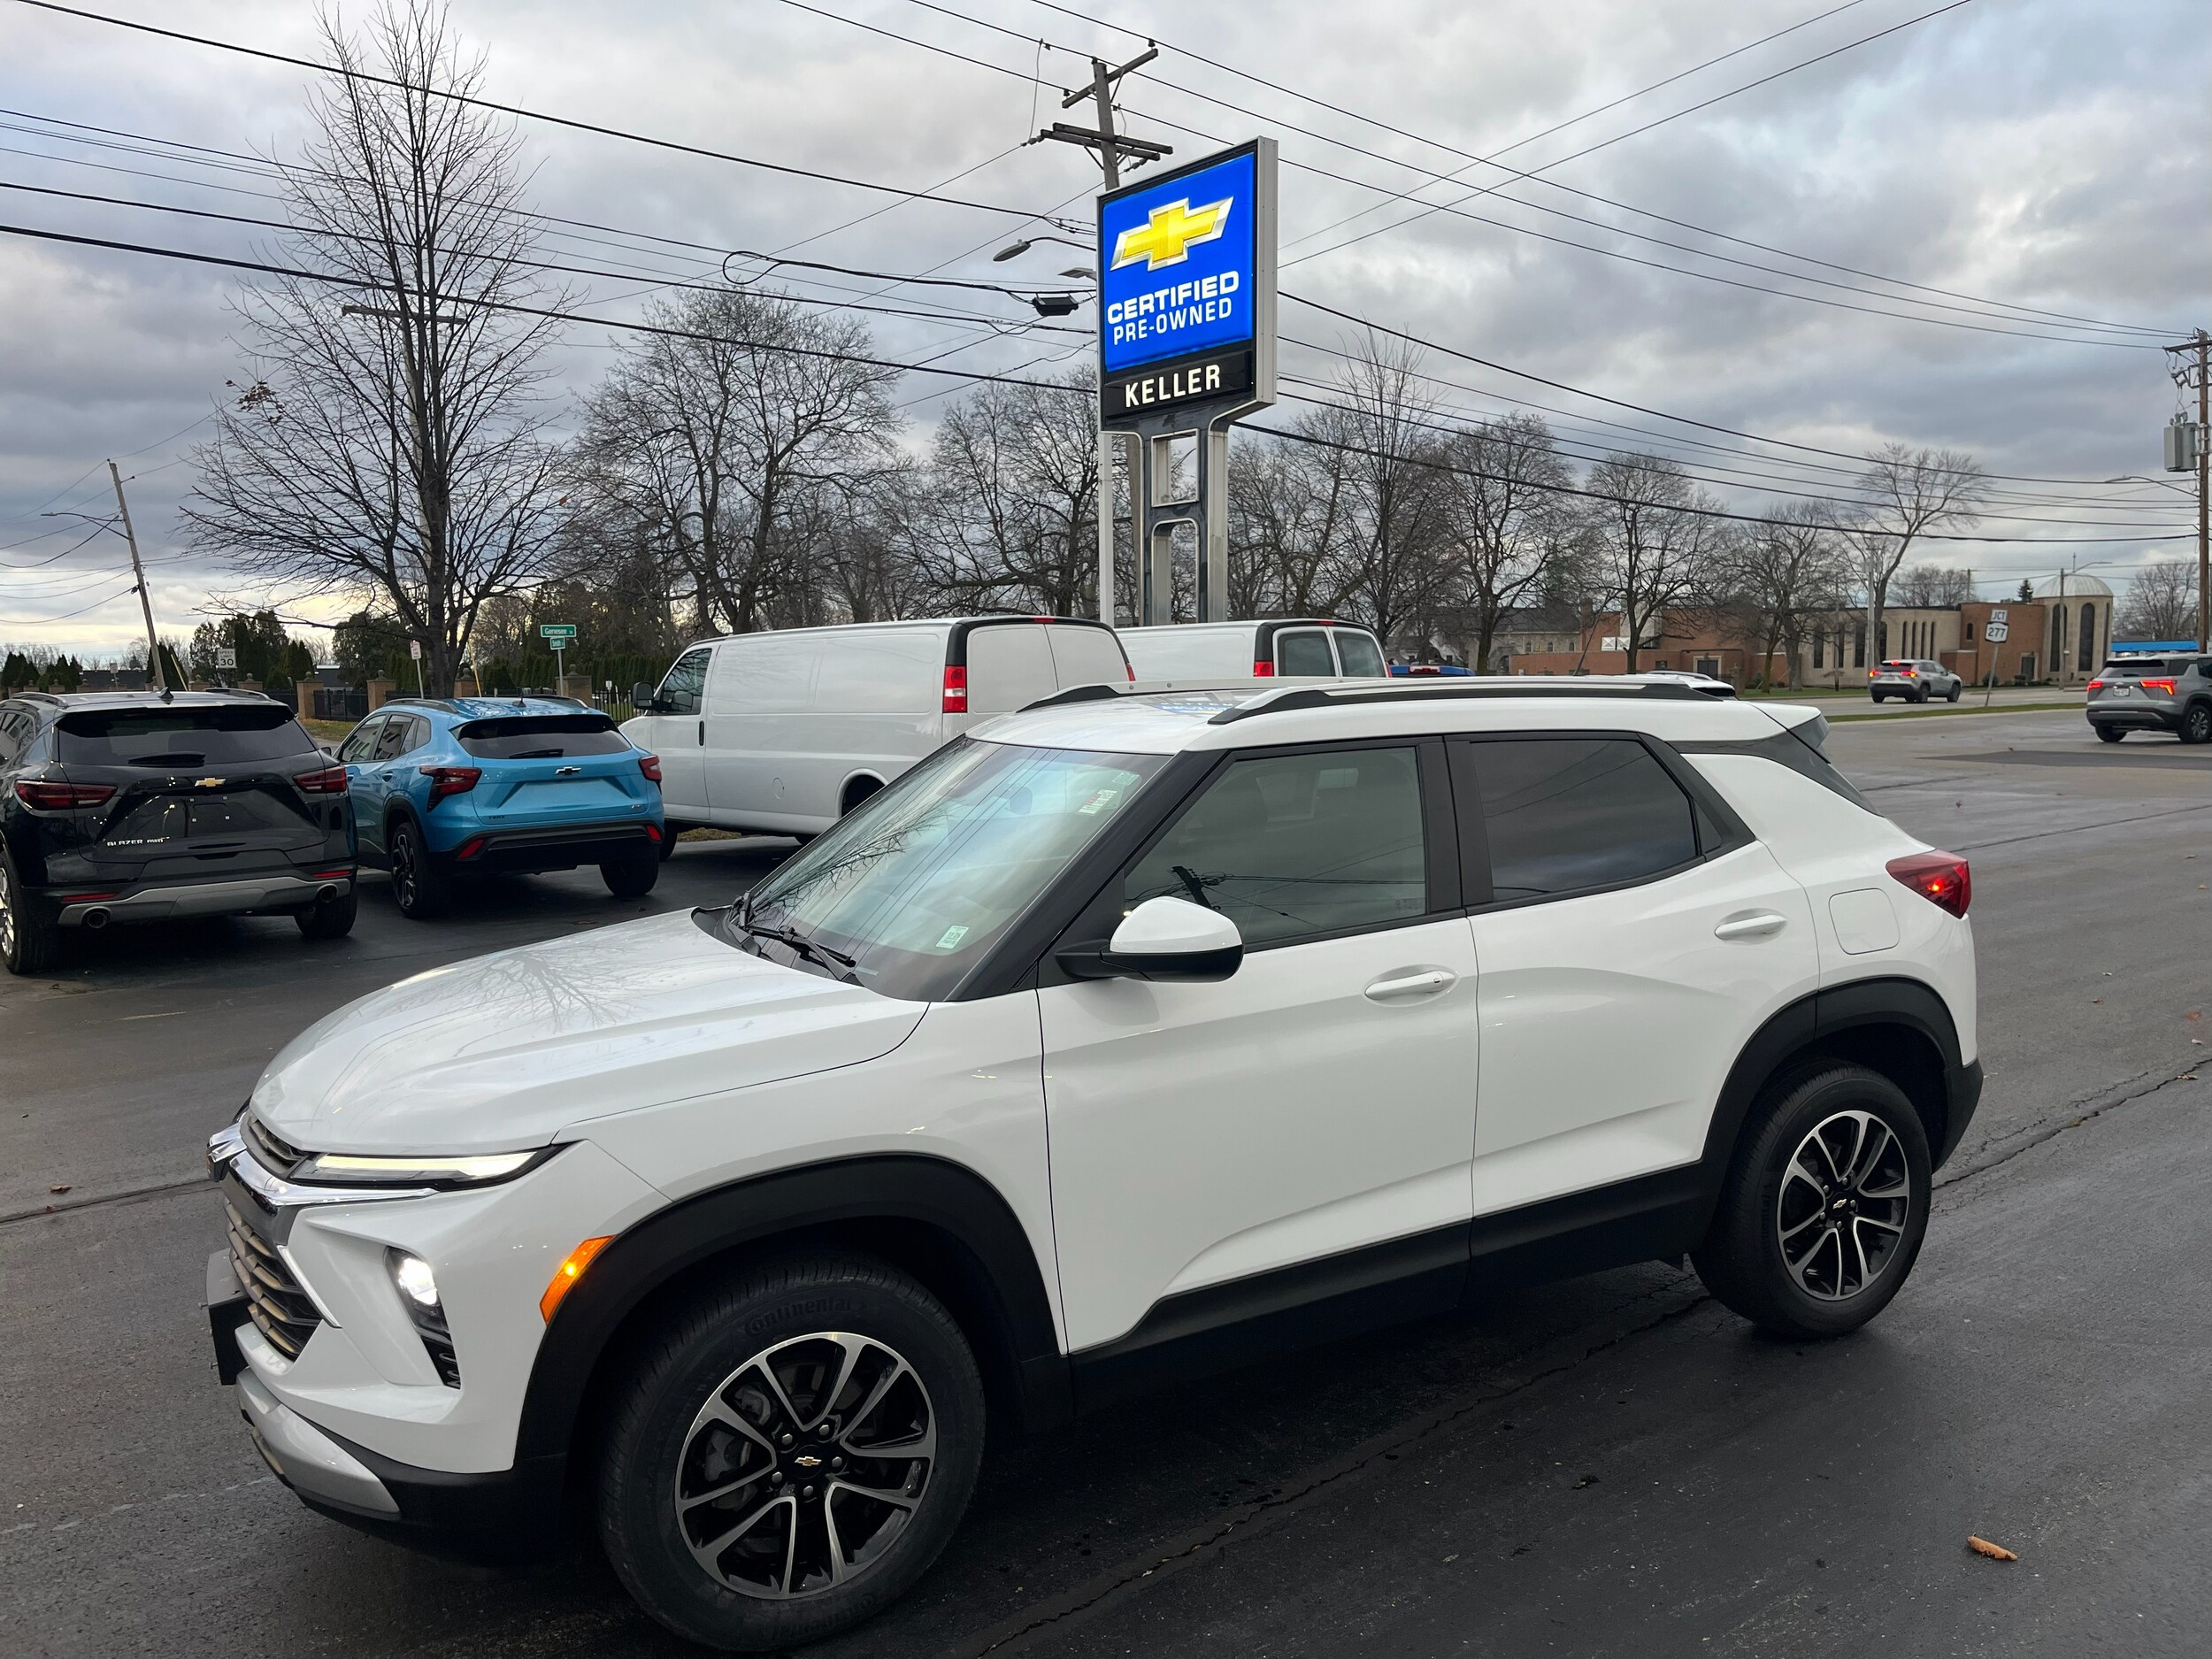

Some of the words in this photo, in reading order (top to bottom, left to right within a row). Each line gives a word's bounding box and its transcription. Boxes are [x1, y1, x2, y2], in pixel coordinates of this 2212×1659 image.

[1107, 270, 1239, 324] CERTIFIED
[1113, 297, 1233, 346] PRE-OWNED
[1125, 364, 1220, 408] KELLER
[1988, 627, 2006, 638] 277
[1992, 611, 2006, 620] JCT
[744, 1295, 851, 1337] Continental
